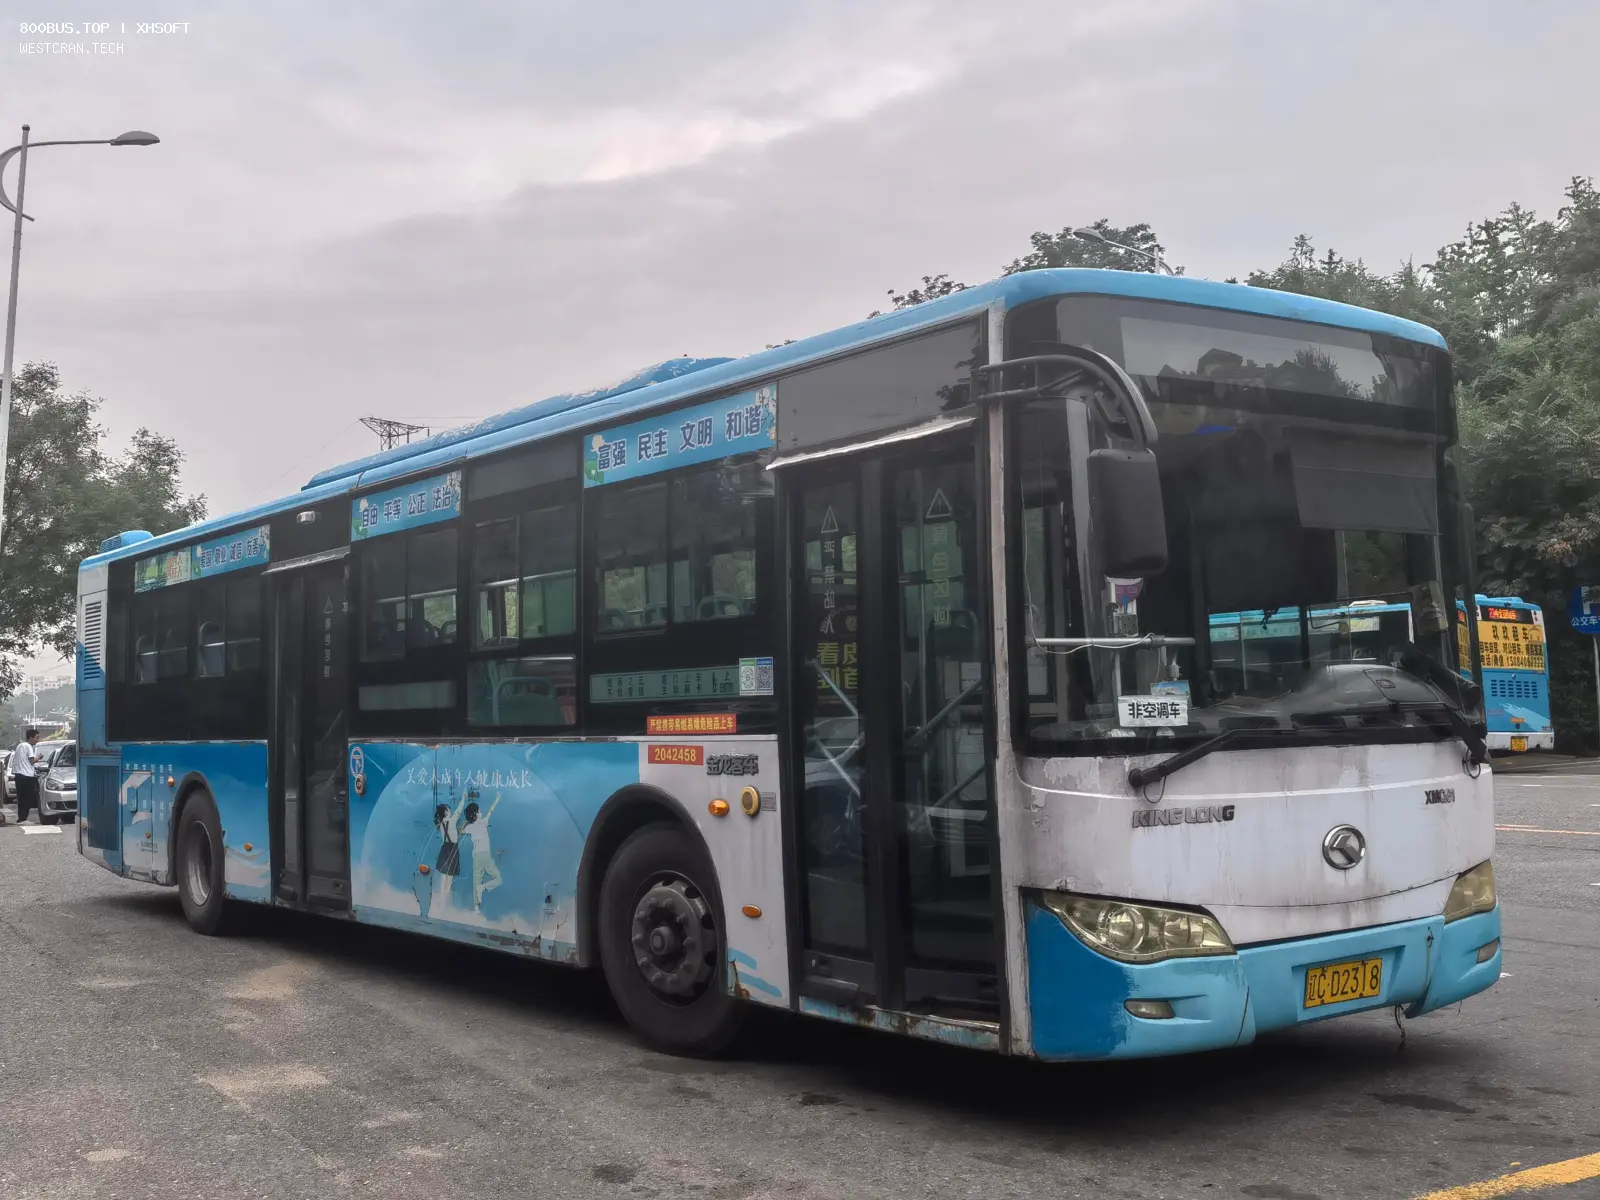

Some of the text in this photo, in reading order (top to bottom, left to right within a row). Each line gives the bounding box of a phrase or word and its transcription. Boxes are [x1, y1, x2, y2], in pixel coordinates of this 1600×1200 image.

[597, 404, 763, 471] 富强 民主 文明 和谐
[362, 484, 453, 528] 自由 平等 公正 法治
[1571, 616, 1600, 627] 公交车
[1127, 701, 1181, 719] 非空调车
[654, 747, 697, 762] 2042458
[706, 753, 760, 776] 金龙客车
[406, 767, 533, 789] 关爱未成年人健康成长
